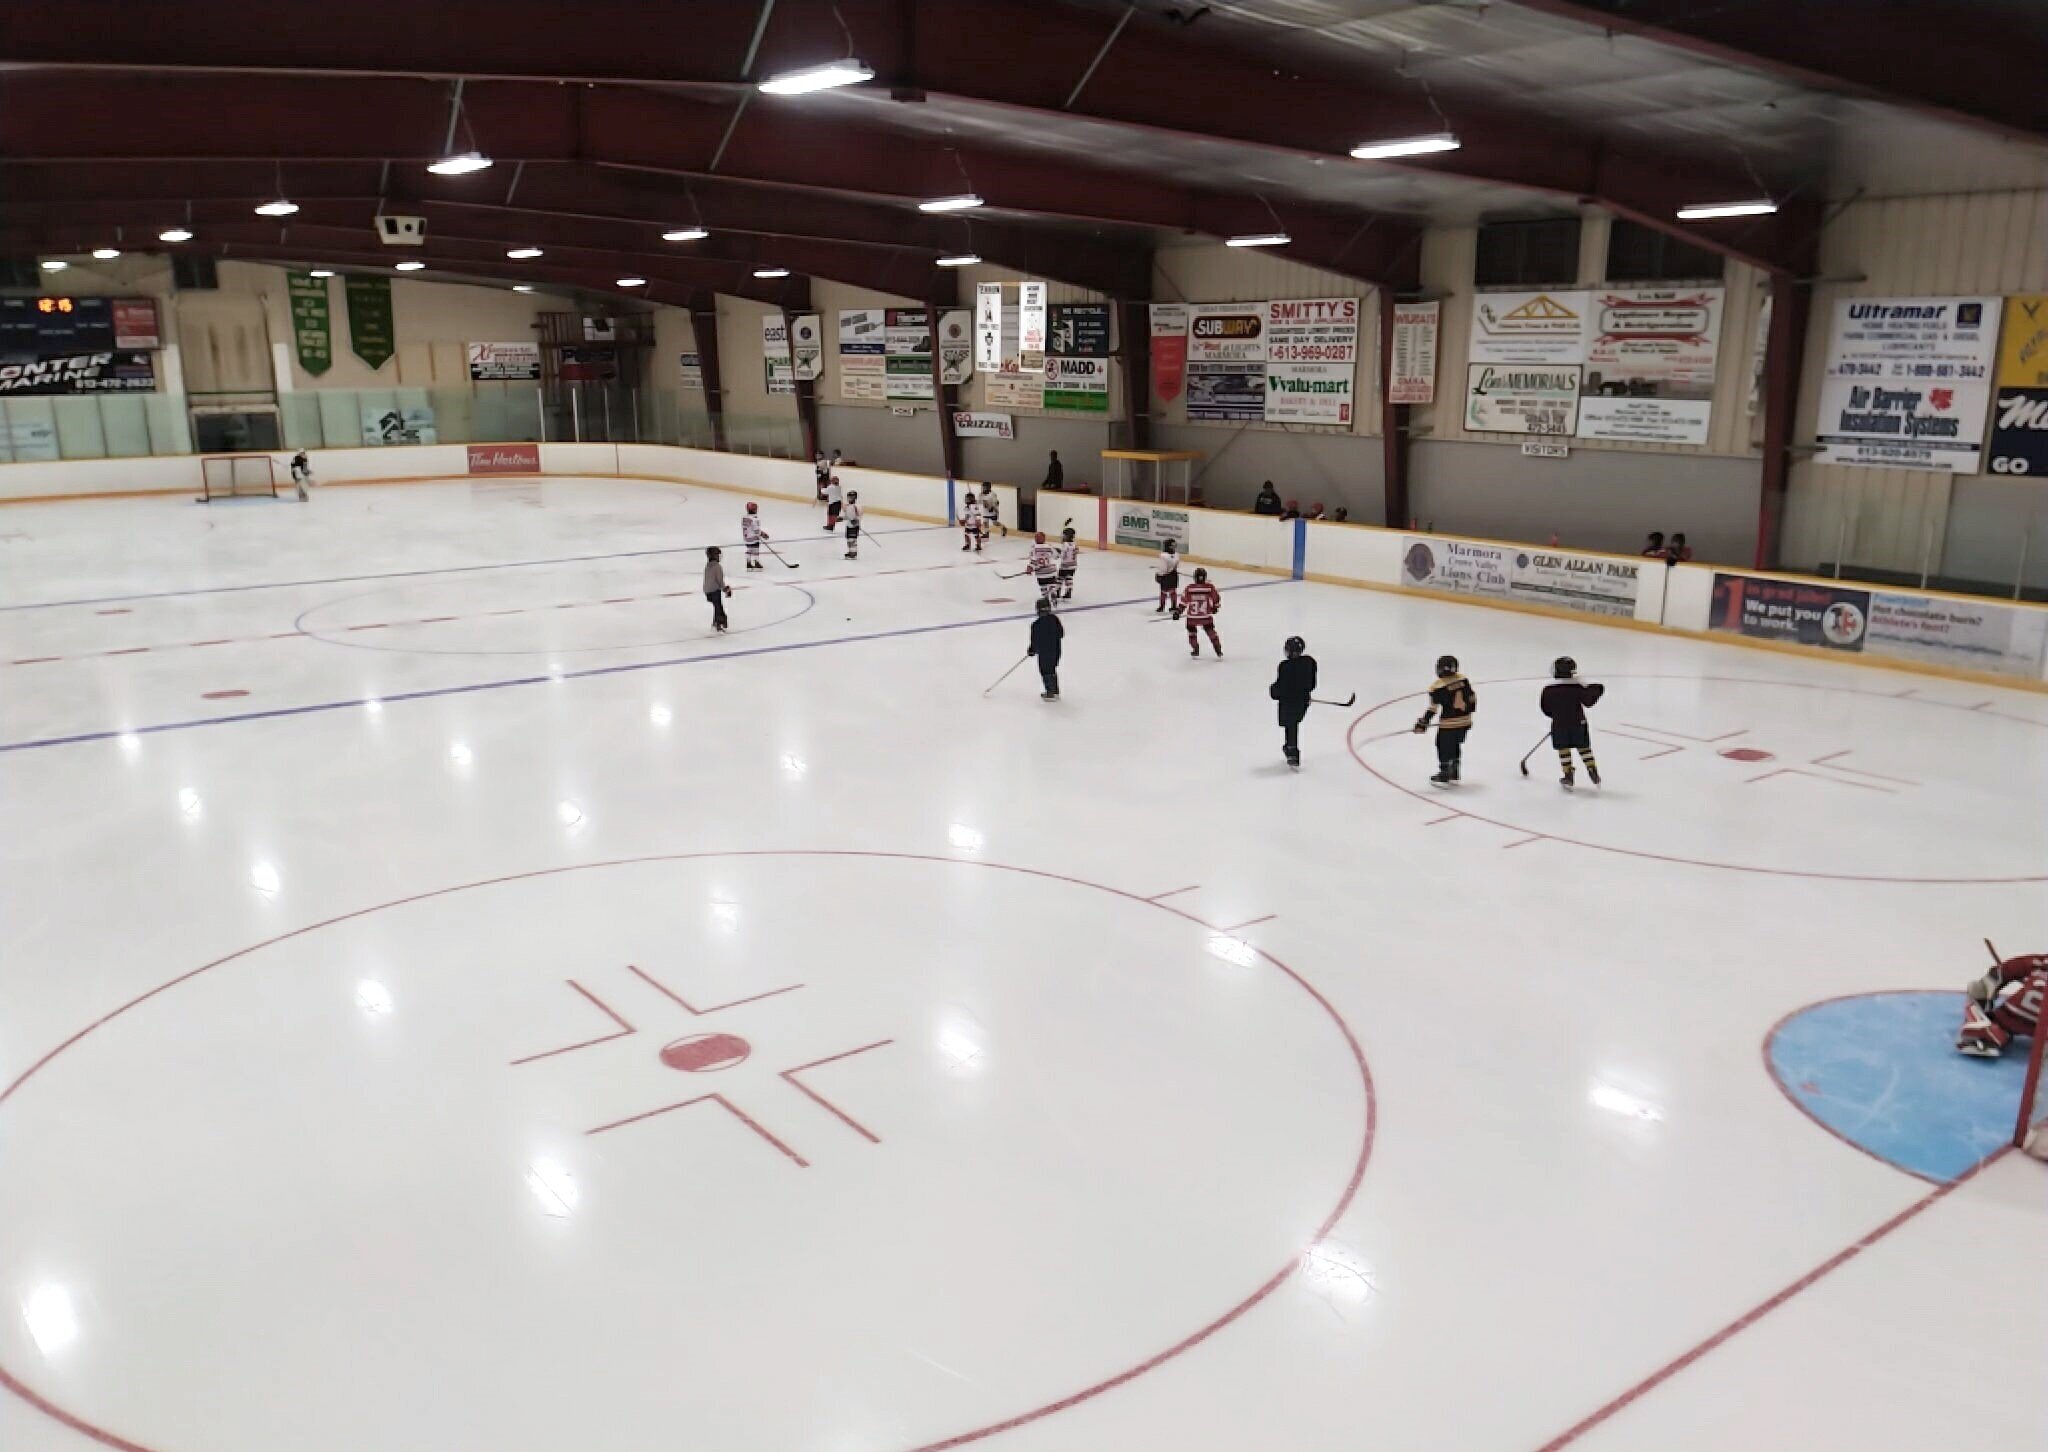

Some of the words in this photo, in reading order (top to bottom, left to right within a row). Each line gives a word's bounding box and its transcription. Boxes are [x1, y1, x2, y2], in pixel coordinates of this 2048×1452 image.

[1270, 300, 1355, 319] SMITTY'S
[1848, 303, 1948, 319] Ultramar
[1195, 319, 1259, 335] SUBWAY
[1060, 360, 1096, 374] MADD
[1904, 411, 1960, 438] Systems
[469, 452, 492, 466] Tim
[492, 451, 539, 465] Hortons
[1992, 457, 2028, 475] GO
[1122, 515, 1150, 531] BMR
[1447, 543, 1502, 561] Marmora
[1440, 565, 1473, 580] Lions
[1476, 571, 1506, 585] Club
[1532, 554, 1563, 569] GLEN
[1564, 558, 1604, 575] ALLAN
[1606, 563, 1640, 579] PARK
[1745, 598, 1767, 613] We
[1767, 604, 1793, 617] put
[1794, 608, 1822, 621] you
[1743, 613, 1758, 626] to
